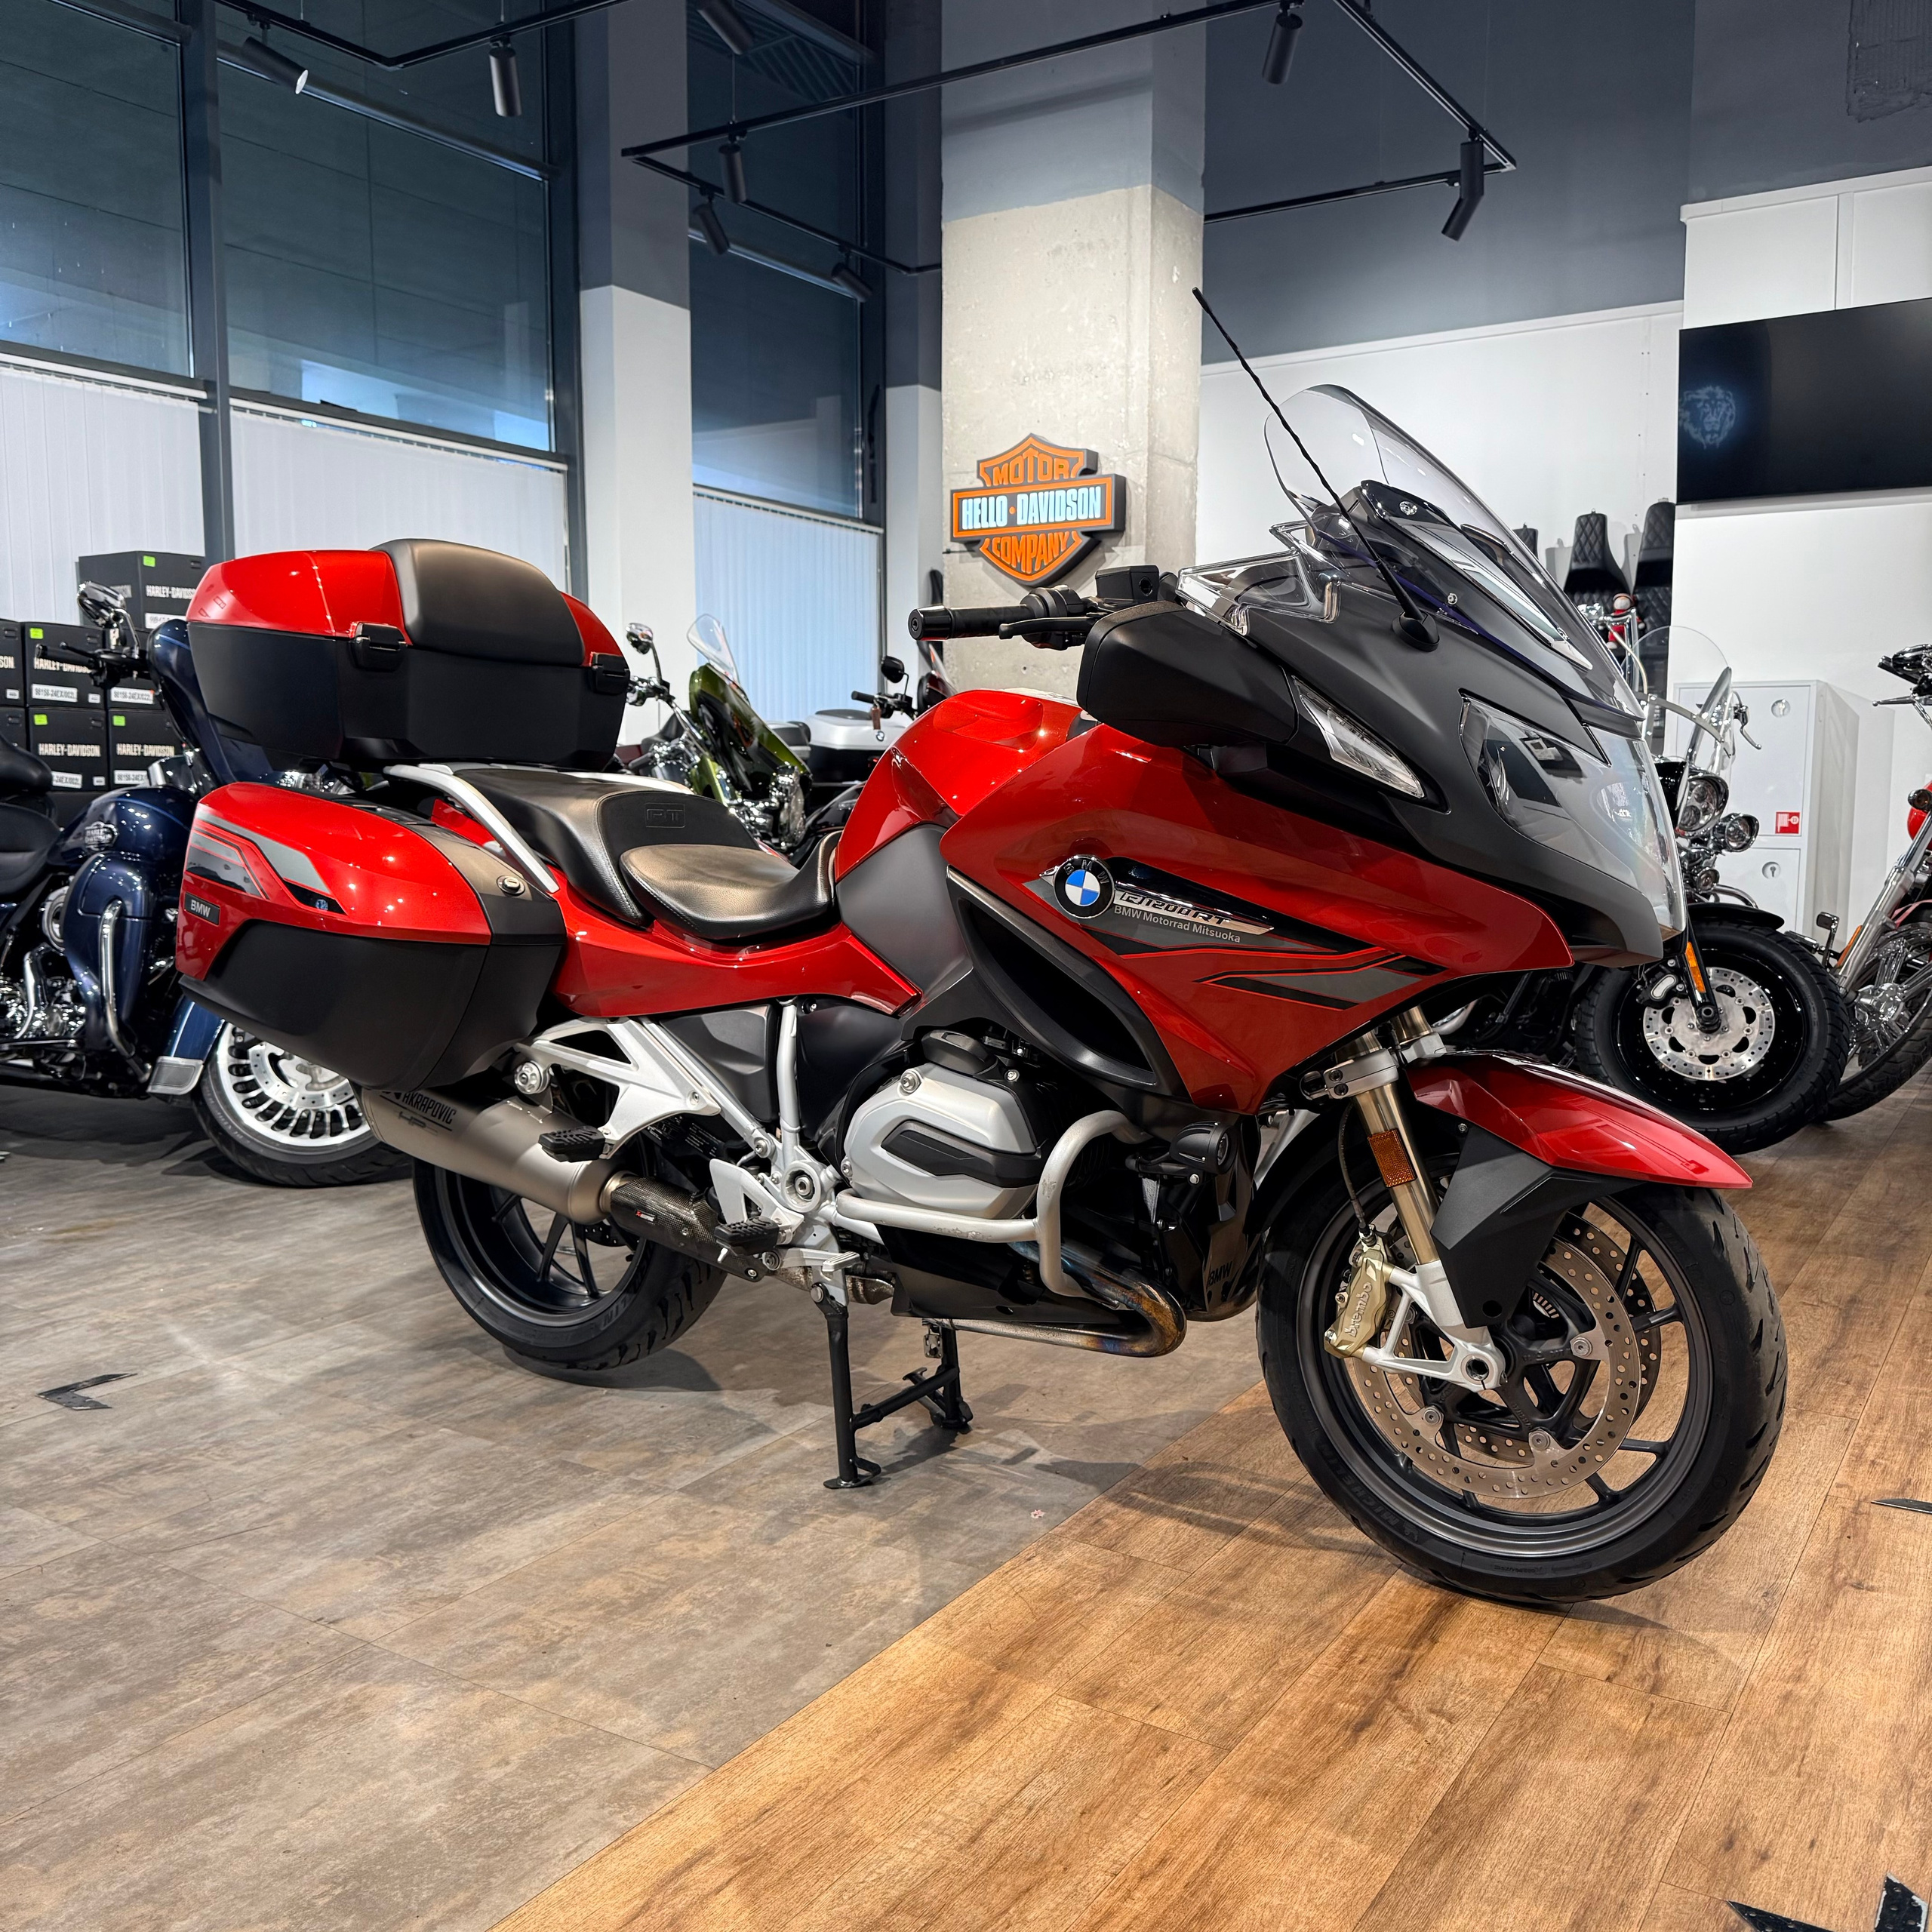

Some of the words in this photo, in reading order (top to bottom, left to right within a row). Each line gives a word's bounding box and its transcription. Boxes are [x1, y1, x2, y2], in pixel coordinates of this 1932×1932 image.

[992, 448, 1070, 485] MOTOR
[961, 495, 1008, 530] HELLO
[1017, 486, 1101, 525] DAVIDSON
[992, 531, 1070, 574] COMPANY
[38, 743, 100, 757] HARLEY-DAVIDSON
[116, 743, 175, 757] HARLEY-DAVIDSON
[1063, 860, 1109, 884] BMW
[190, 900, 211, 918] BMW
[1114, 906, 1142, 919] BMW
[1143, 911, 1190, 931] Motorrad
[1192, 923, 1241, 943] Mitsuoka
[1208, 1261, 1233, 1286] BMW
[1345, 1282, 1373, 1337] brembo
